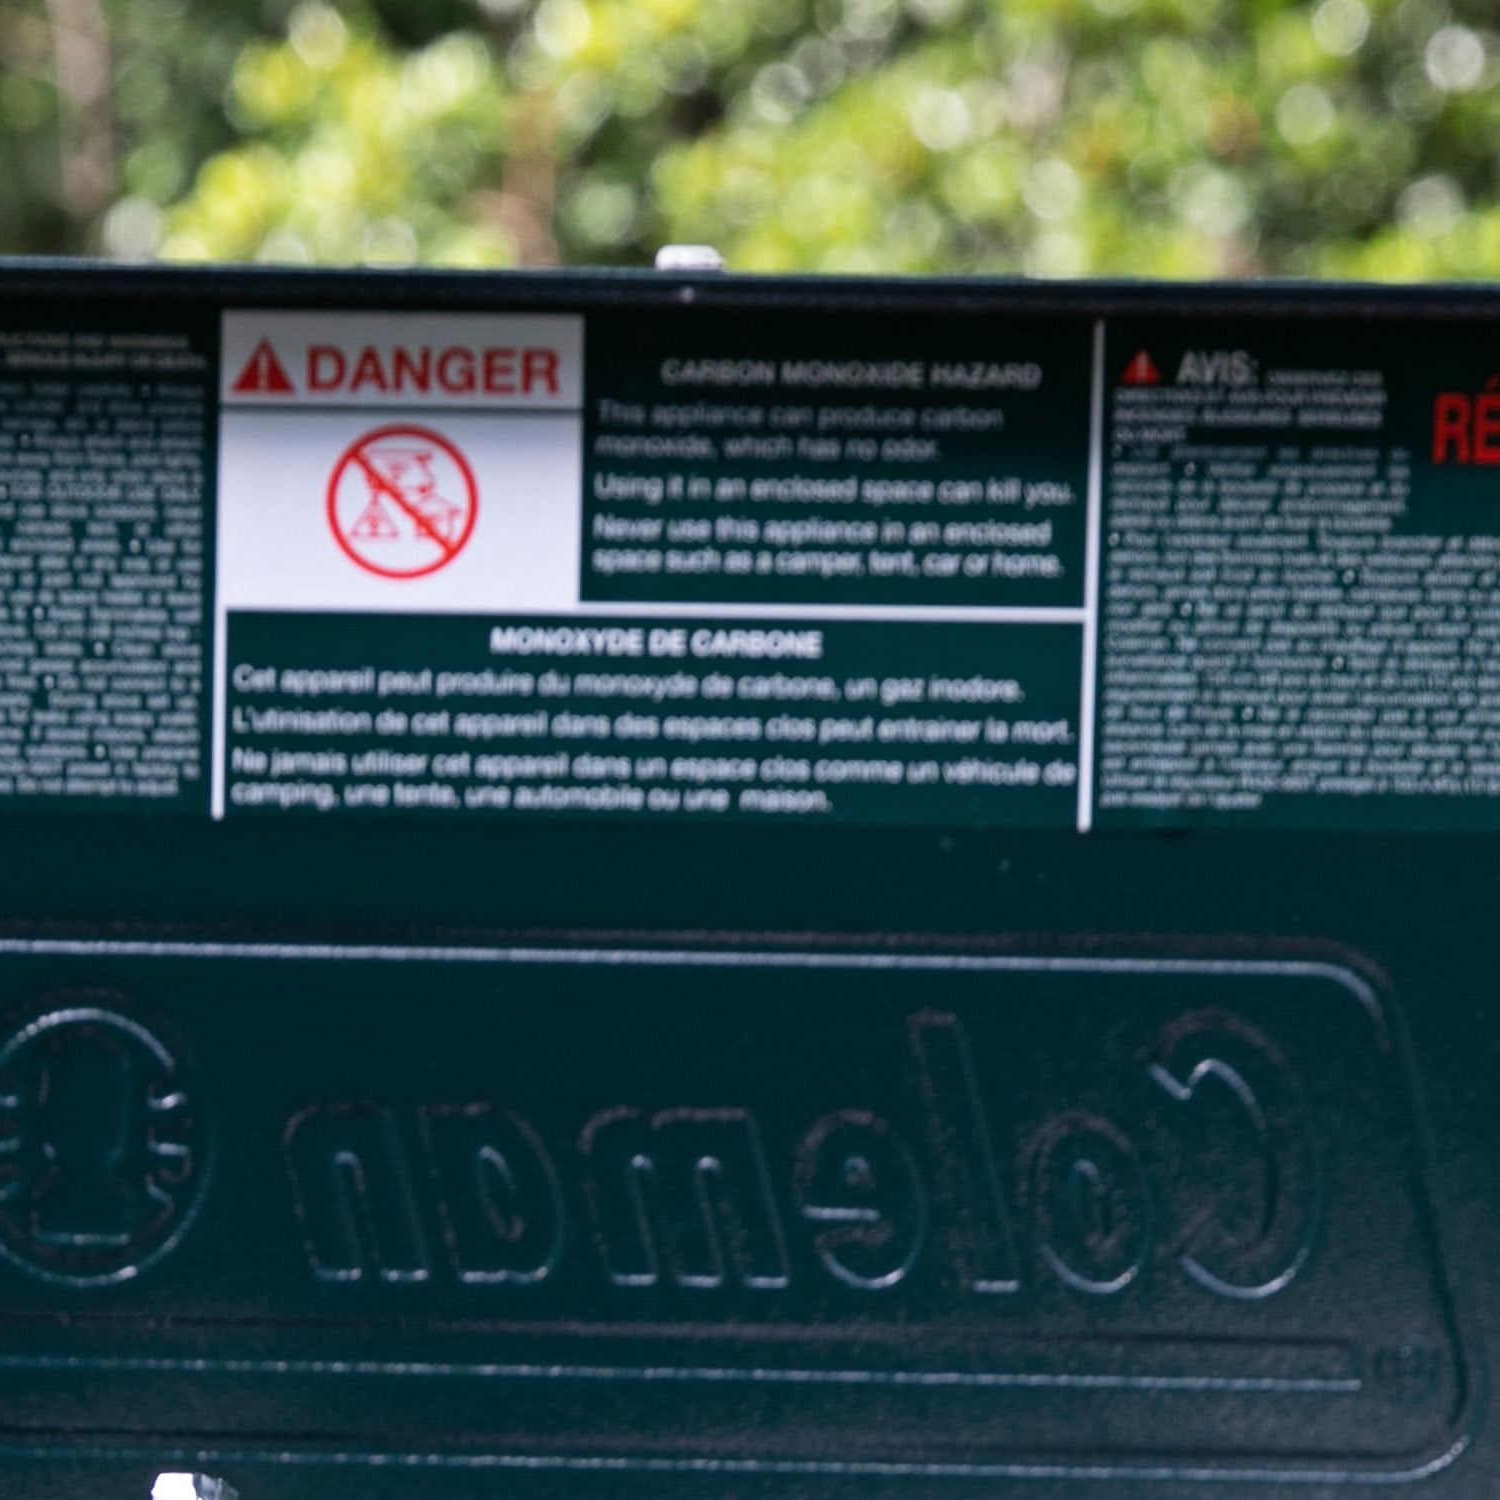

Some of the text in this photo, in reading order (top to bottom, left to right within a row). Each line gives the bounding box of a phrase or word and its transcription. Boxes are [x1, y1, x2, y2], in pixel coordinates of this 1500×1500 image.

[304, 345, 561, 394] DANGER
[662, 358, 1043, 389] CARBON MONOXIDE HAZARD
[1174, 350, 1259, 386] AVIS:
[597, 398, 1004, 432] This appliance can produce carbon
[723, 434, 793, 461] which
[796, 436, 841, 461] has
[845, 438, 878, 463] no
[593, 473, 1076, 510] Using it in an enclosed space can kill you.
[592, 514, 1053, 547] Never use this appliance in an enclosed
[592, 549, 663, 574] space
[665, 547, 721, 573] such
[724, 550, 752, 574] as
[755, 551, 772, 574] a
[922, 553, 961, 576] car
[963, 553, 989, 577] or
[490, 626, 824, 657] MONOXYDE DE CARBONE
[233, 664, 276, 692] Cet
[280, 667, 375, 695] appareil
[378, 669, 432, 696] peut
[436, 669, 535, 696] produire
[537, 669, 571, 697] du
[574, 672, 699, 701] monoxyde
[701, 672, 734, 699] de
[844, 678, 876, 701] un
[880, 678, 925, 705] gaz
[375, 709, 408, 735] de
[411, 710, 450, 735] cet
[453, 711, 549, 738] appareil
[551, 711, 611, 738] dans
[613, 712, 659, 739] des
[663, 716, 763, 741] espaces
[765, 714, 816, 741] clos
[818, 716, 874, 744] peut
[984, 717, 1009, 744] la
[232, 747, 268, 774] Ne
[270, 750, 347, 778] jamais
[351, 750, 428, 776] utiliser
[432, 752, 471, 777] cet
[474, 752, 570, 780] appareil
[572, 752, 632, 779] dans
[635, 757, 667, 780] un
[670, 757, 757, 783] espace
[759, 755, 811, 782] clos
[814, 759, 904, 783] comme
[906, 760, 940, 784] un
[1042, 759, 1077, 786] de
[343, 784, 390, 807] une
[465, 785, 511, 808] une
[514, 784, 644, 810] automobile
[647, 788, 679, 811] ou
[683, 788, 730, 812] une
